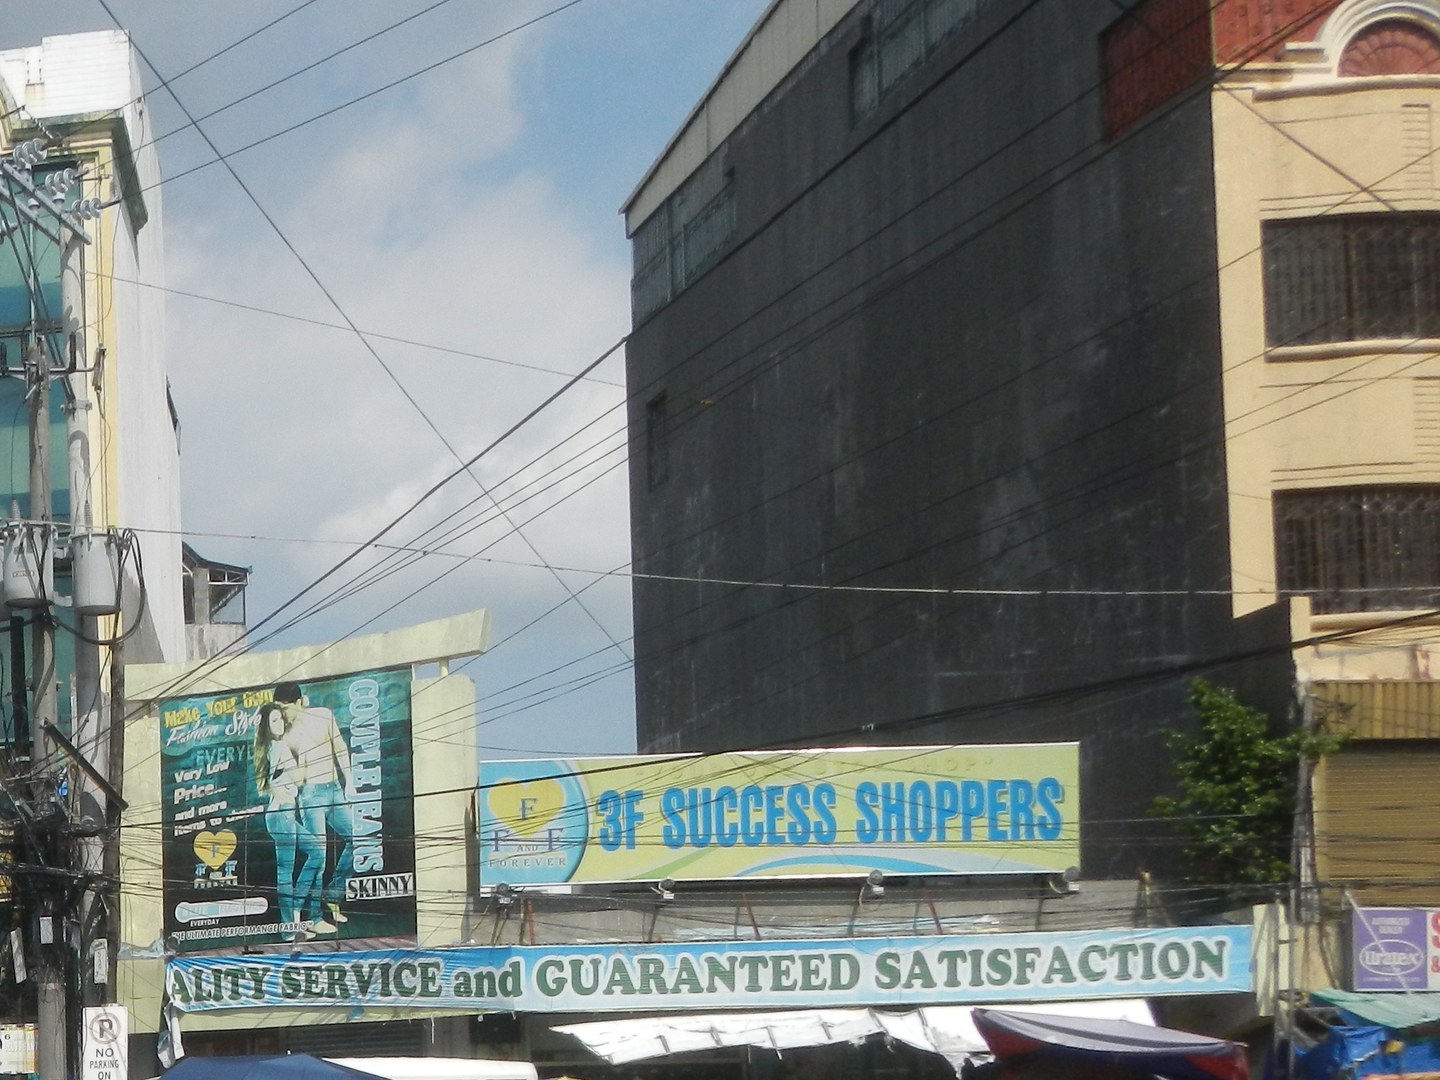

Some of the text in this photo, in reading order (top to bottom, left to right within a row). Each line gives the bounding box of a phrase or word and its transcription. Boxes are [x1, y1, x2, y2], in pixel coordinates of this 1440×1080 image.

[598, 776, 1065, 853] 3F SUCCESS SHOPPERS
[489, 857, 567, 868] FOREVER
[346, 874, 412, 900] SKINNY
[190, 919, 220, 928] EVERYDAY
[186, 928, 220, 940] ULTIMATE
[220, 923, 278, 938] PERFORMANCE
[278, 960, 443, 1000] SERVICE
[454, 960, 524, 999] and
[534, 952, 862, 998] GUARANTEED
[873, 939, 1228, 991] SATISFACTION
[95, 1047, 114, 1058] NO
[89, 1059, 120, 1070] PARKING
[97, 1071, 111, 1080] ON
